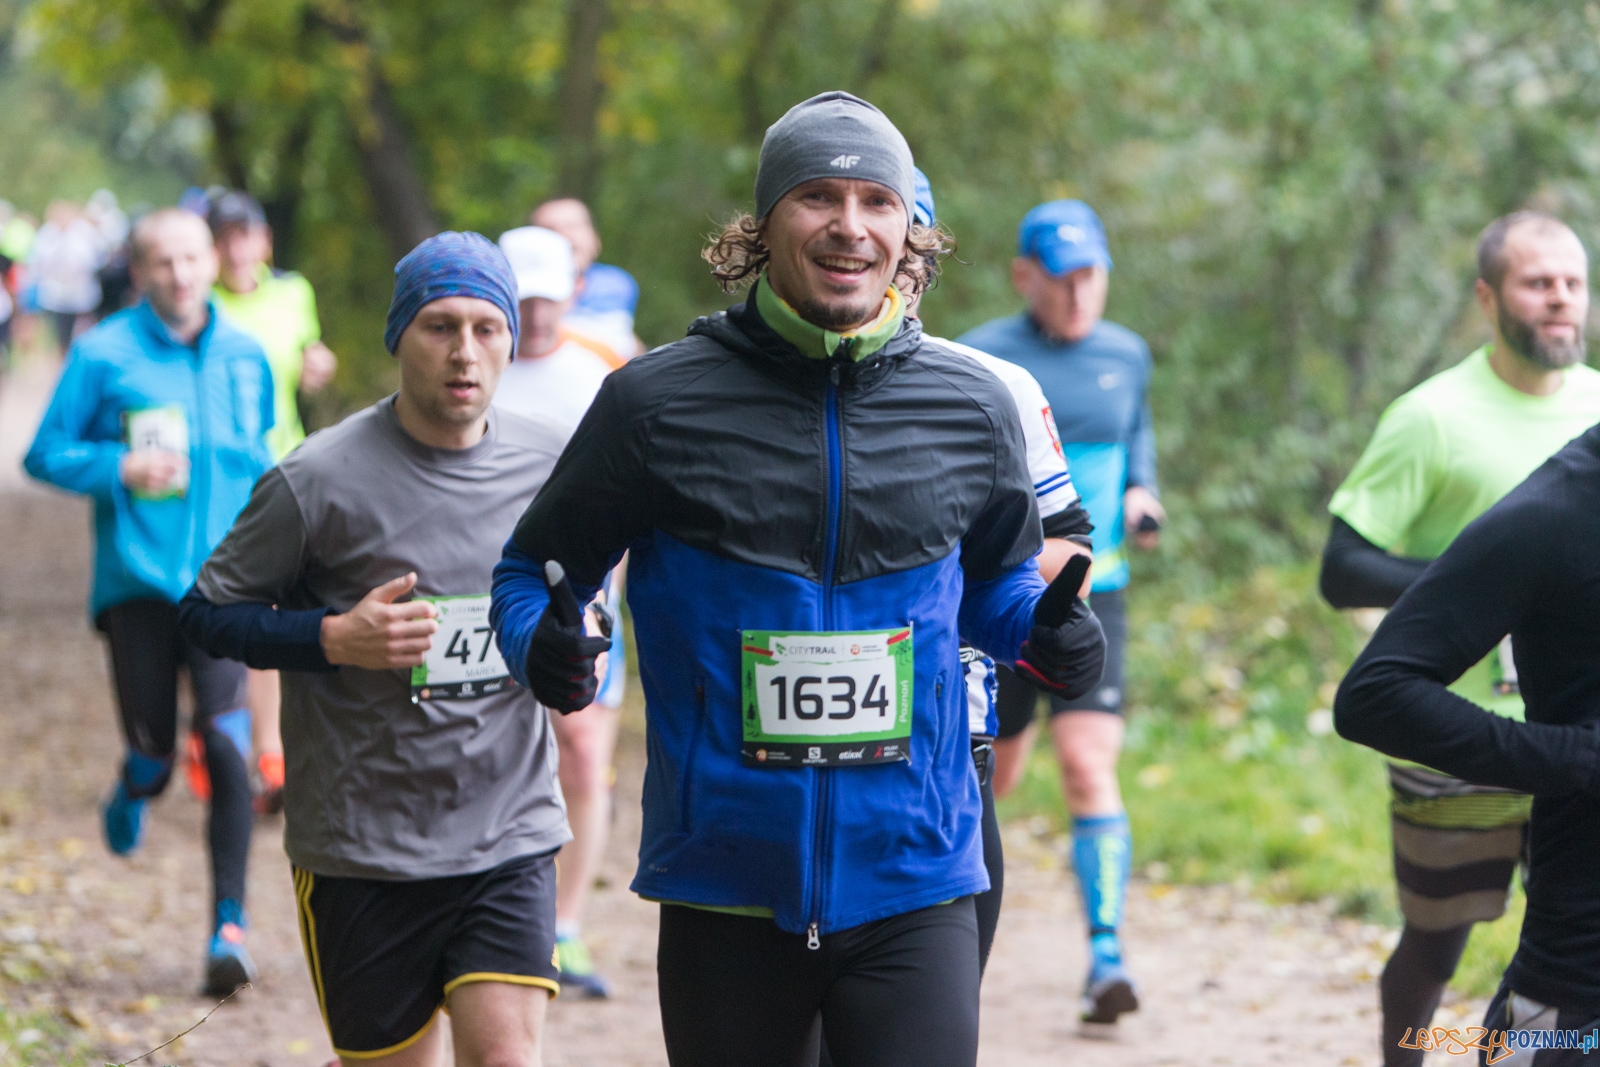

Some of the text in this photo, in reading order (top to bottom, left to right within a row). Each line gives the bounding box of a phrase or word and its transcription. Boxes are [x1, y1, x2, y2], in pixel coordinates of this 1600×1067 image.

[829, 154, 861, 169] 4F
[444, 626, 494, 665] 47
[465, 665, 497, 679] MAREK
[769, 674, 889, 721] 1634
